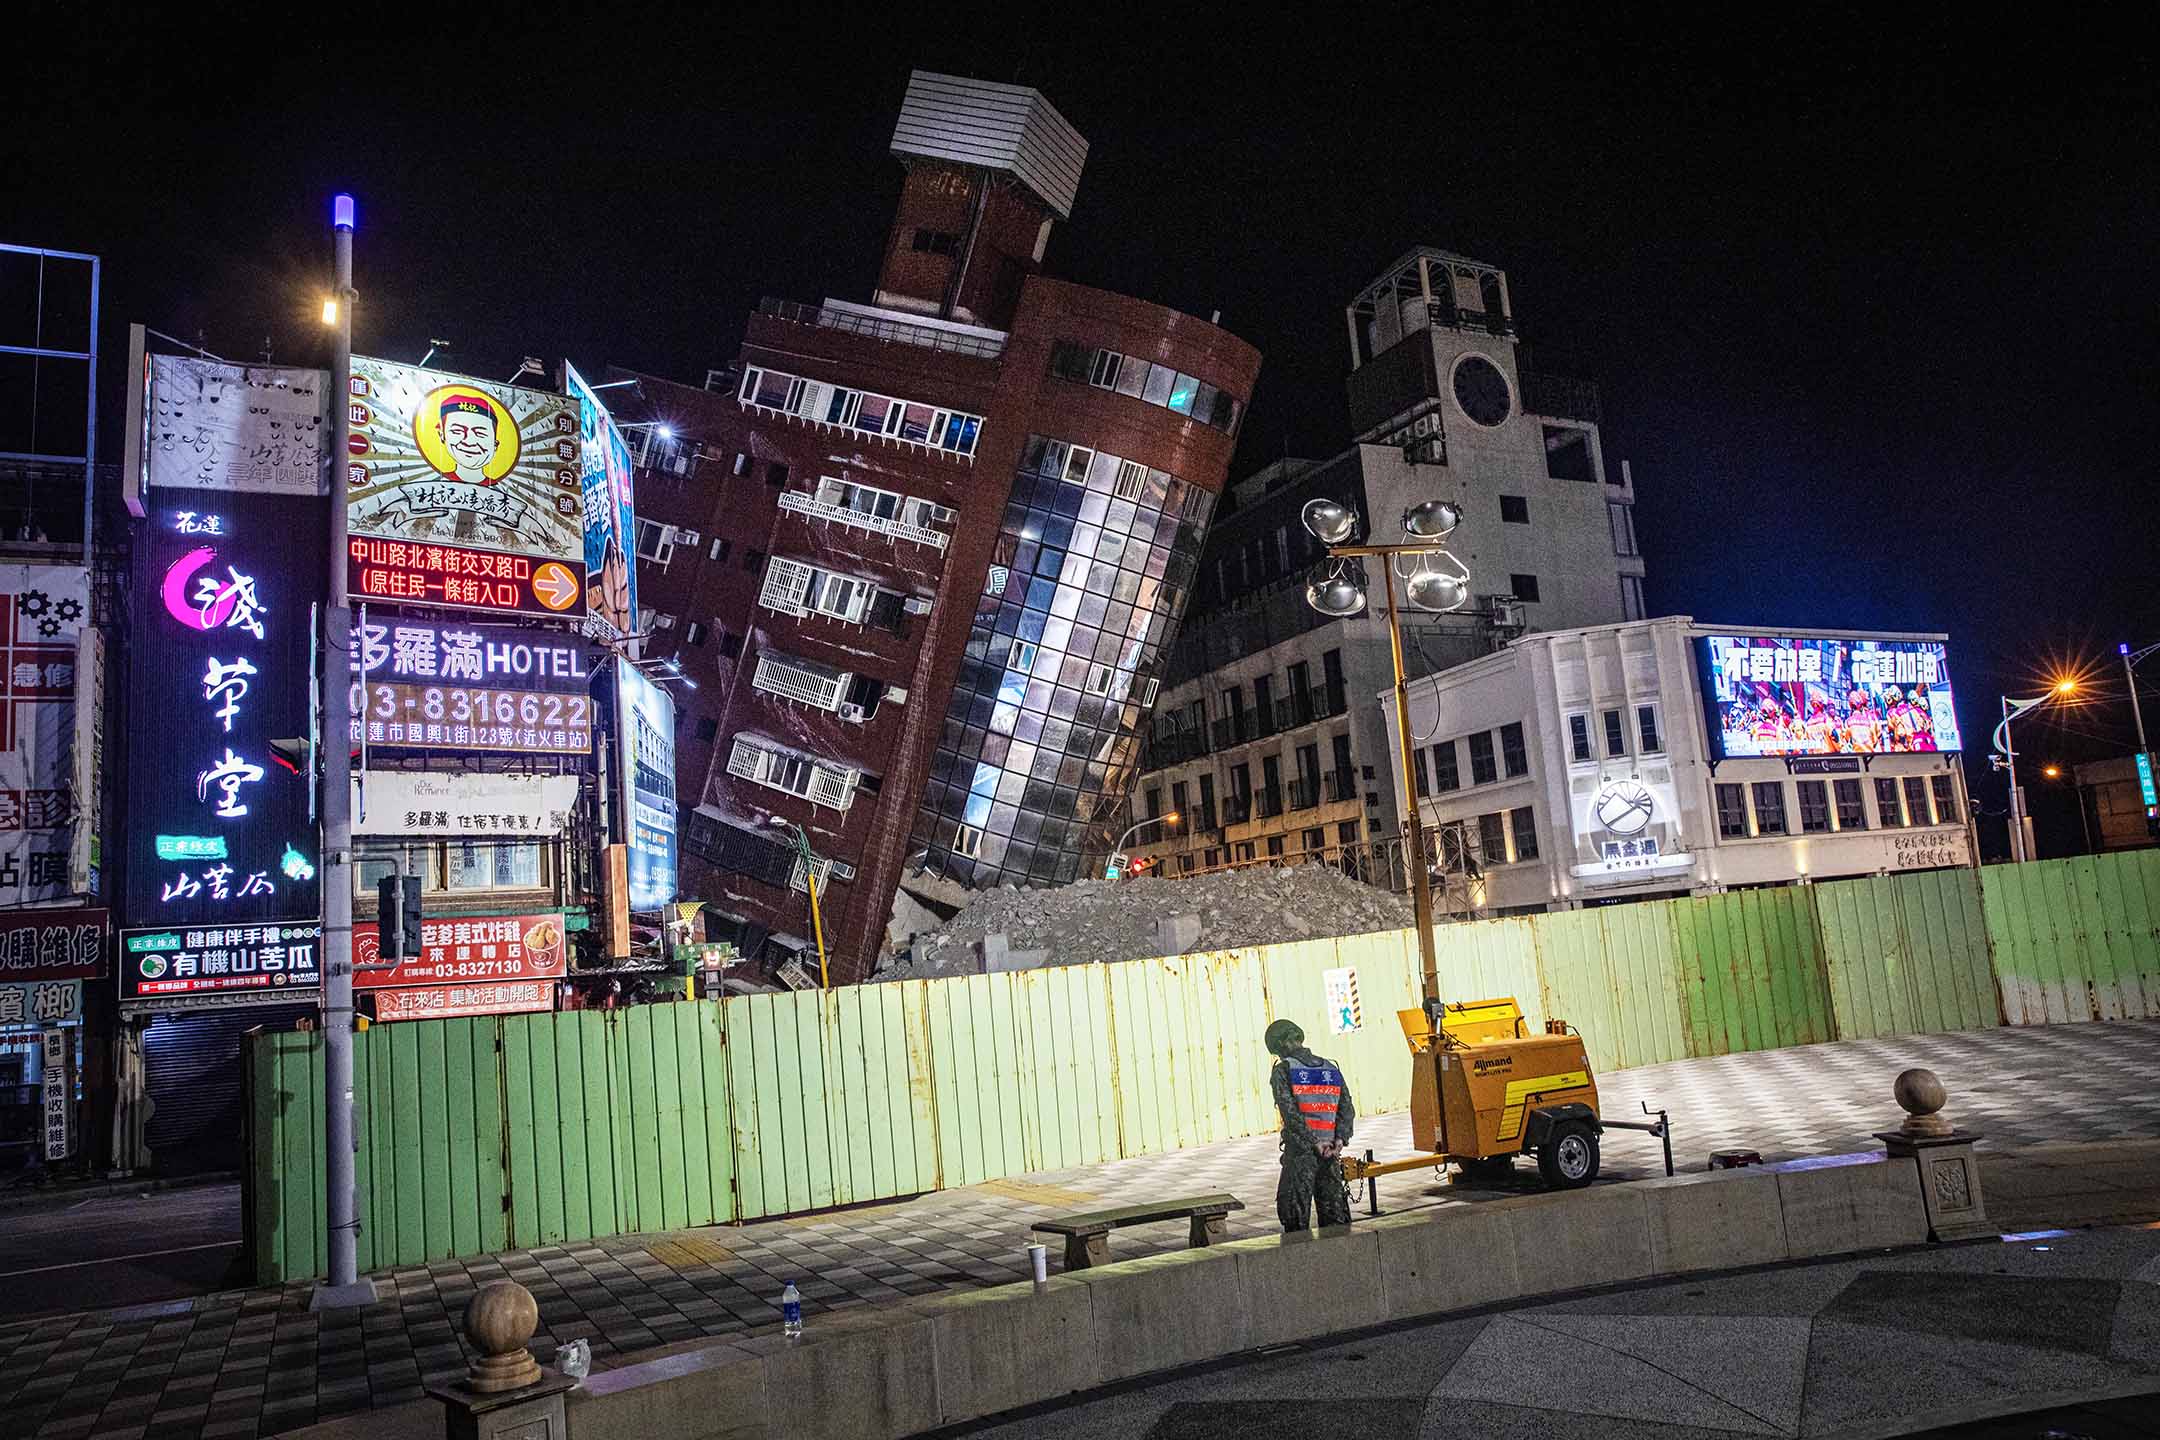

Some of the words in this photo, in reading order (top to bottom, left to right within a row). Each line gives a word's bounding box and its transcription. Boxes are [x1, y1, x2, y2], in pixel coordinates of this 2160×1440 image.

[557, 416, 577, 514] 別無分號
[175, 511, 224, 535] 花蓮
[351, 538, 529, 580] 中山路北濱街交叉路口
[362, 568, 519, 607] (原住民一條街入口)
[350, 624, 483, 680] 多羅滿
[486, 642, 587, 678] HOTEL
[1724, 647, 1822, 682] 不要放棄
[1851, 650, 1938, 683] 花蓮加油
[13, 662, 74, 688] 急修
[350, 683, 587, 727] 03-8316622
[403, 810, 450, 829] 多羅滿
[0, 925, 100, 968] 購維修
[186, 927, 280, 948] 健康伴手禮
[172, 944, 314, 977] 有機山苦瓜
[435, 959, 522, 977] 03-8327130
[1474, 1056, 1513, 1071] Allmand
[48, 1068, 65, 1158] 手機收購維修
